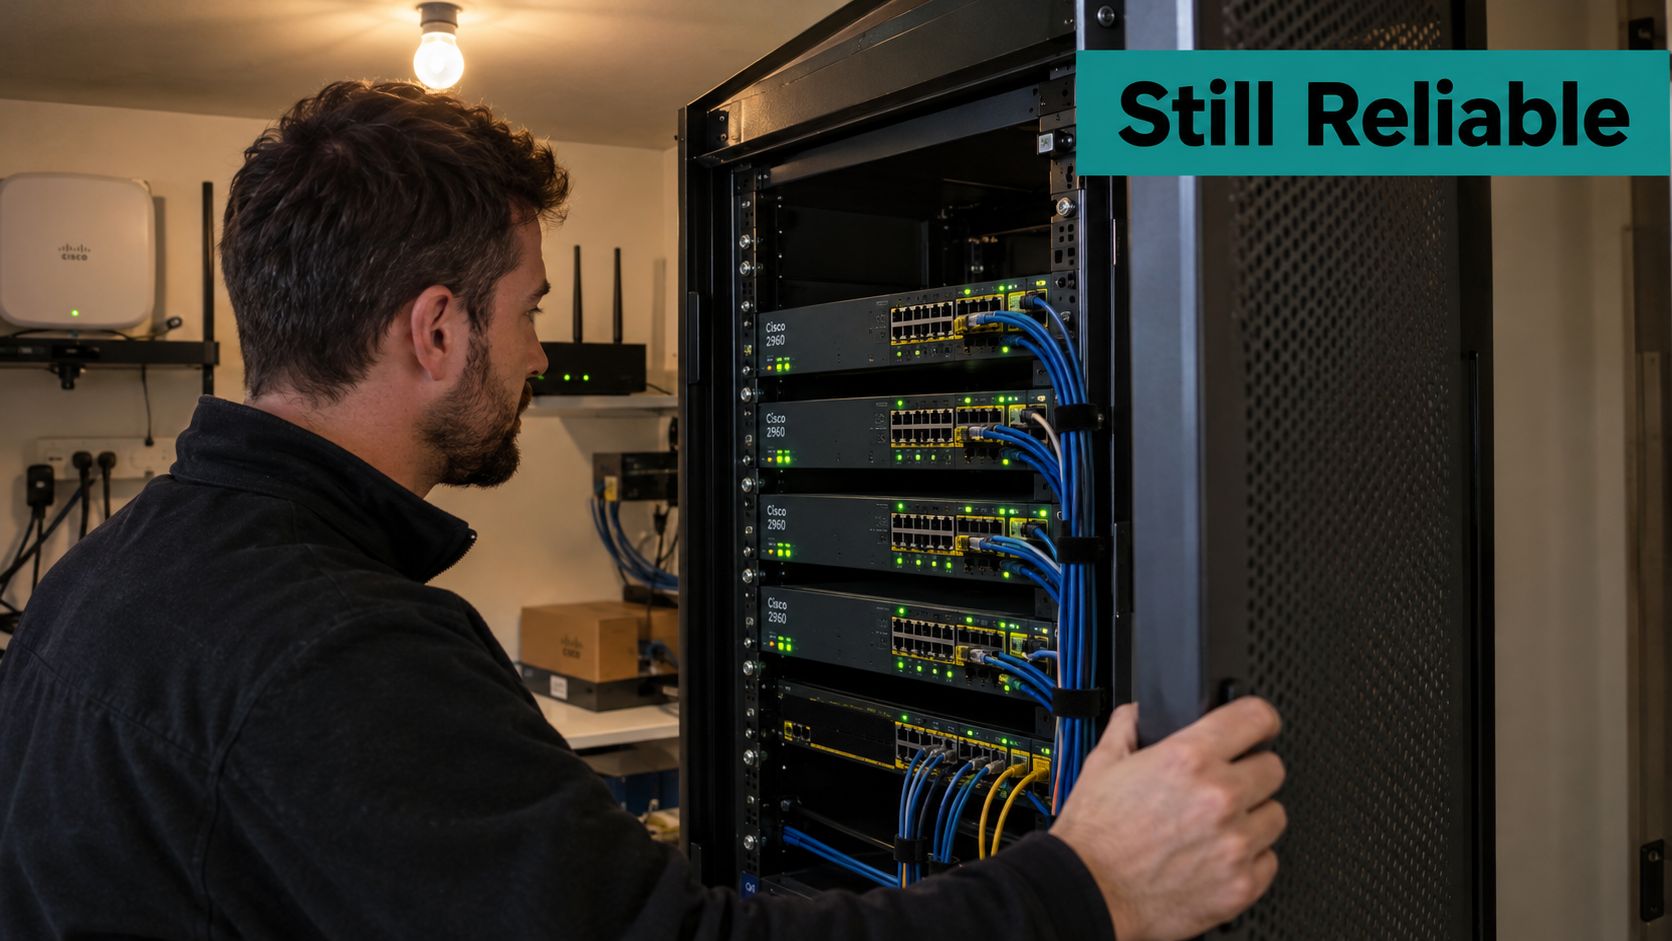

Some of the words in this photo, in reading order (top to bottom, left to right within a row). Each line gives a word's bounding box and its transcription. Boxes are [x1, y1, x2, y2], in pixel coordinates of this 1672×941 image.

[765, 321, 786, 333] Cisco
[766, 412, 786, 424] Cisco
[767, 504, 787, 517] Cisco
[767, 597, 787, 610] Cisco
